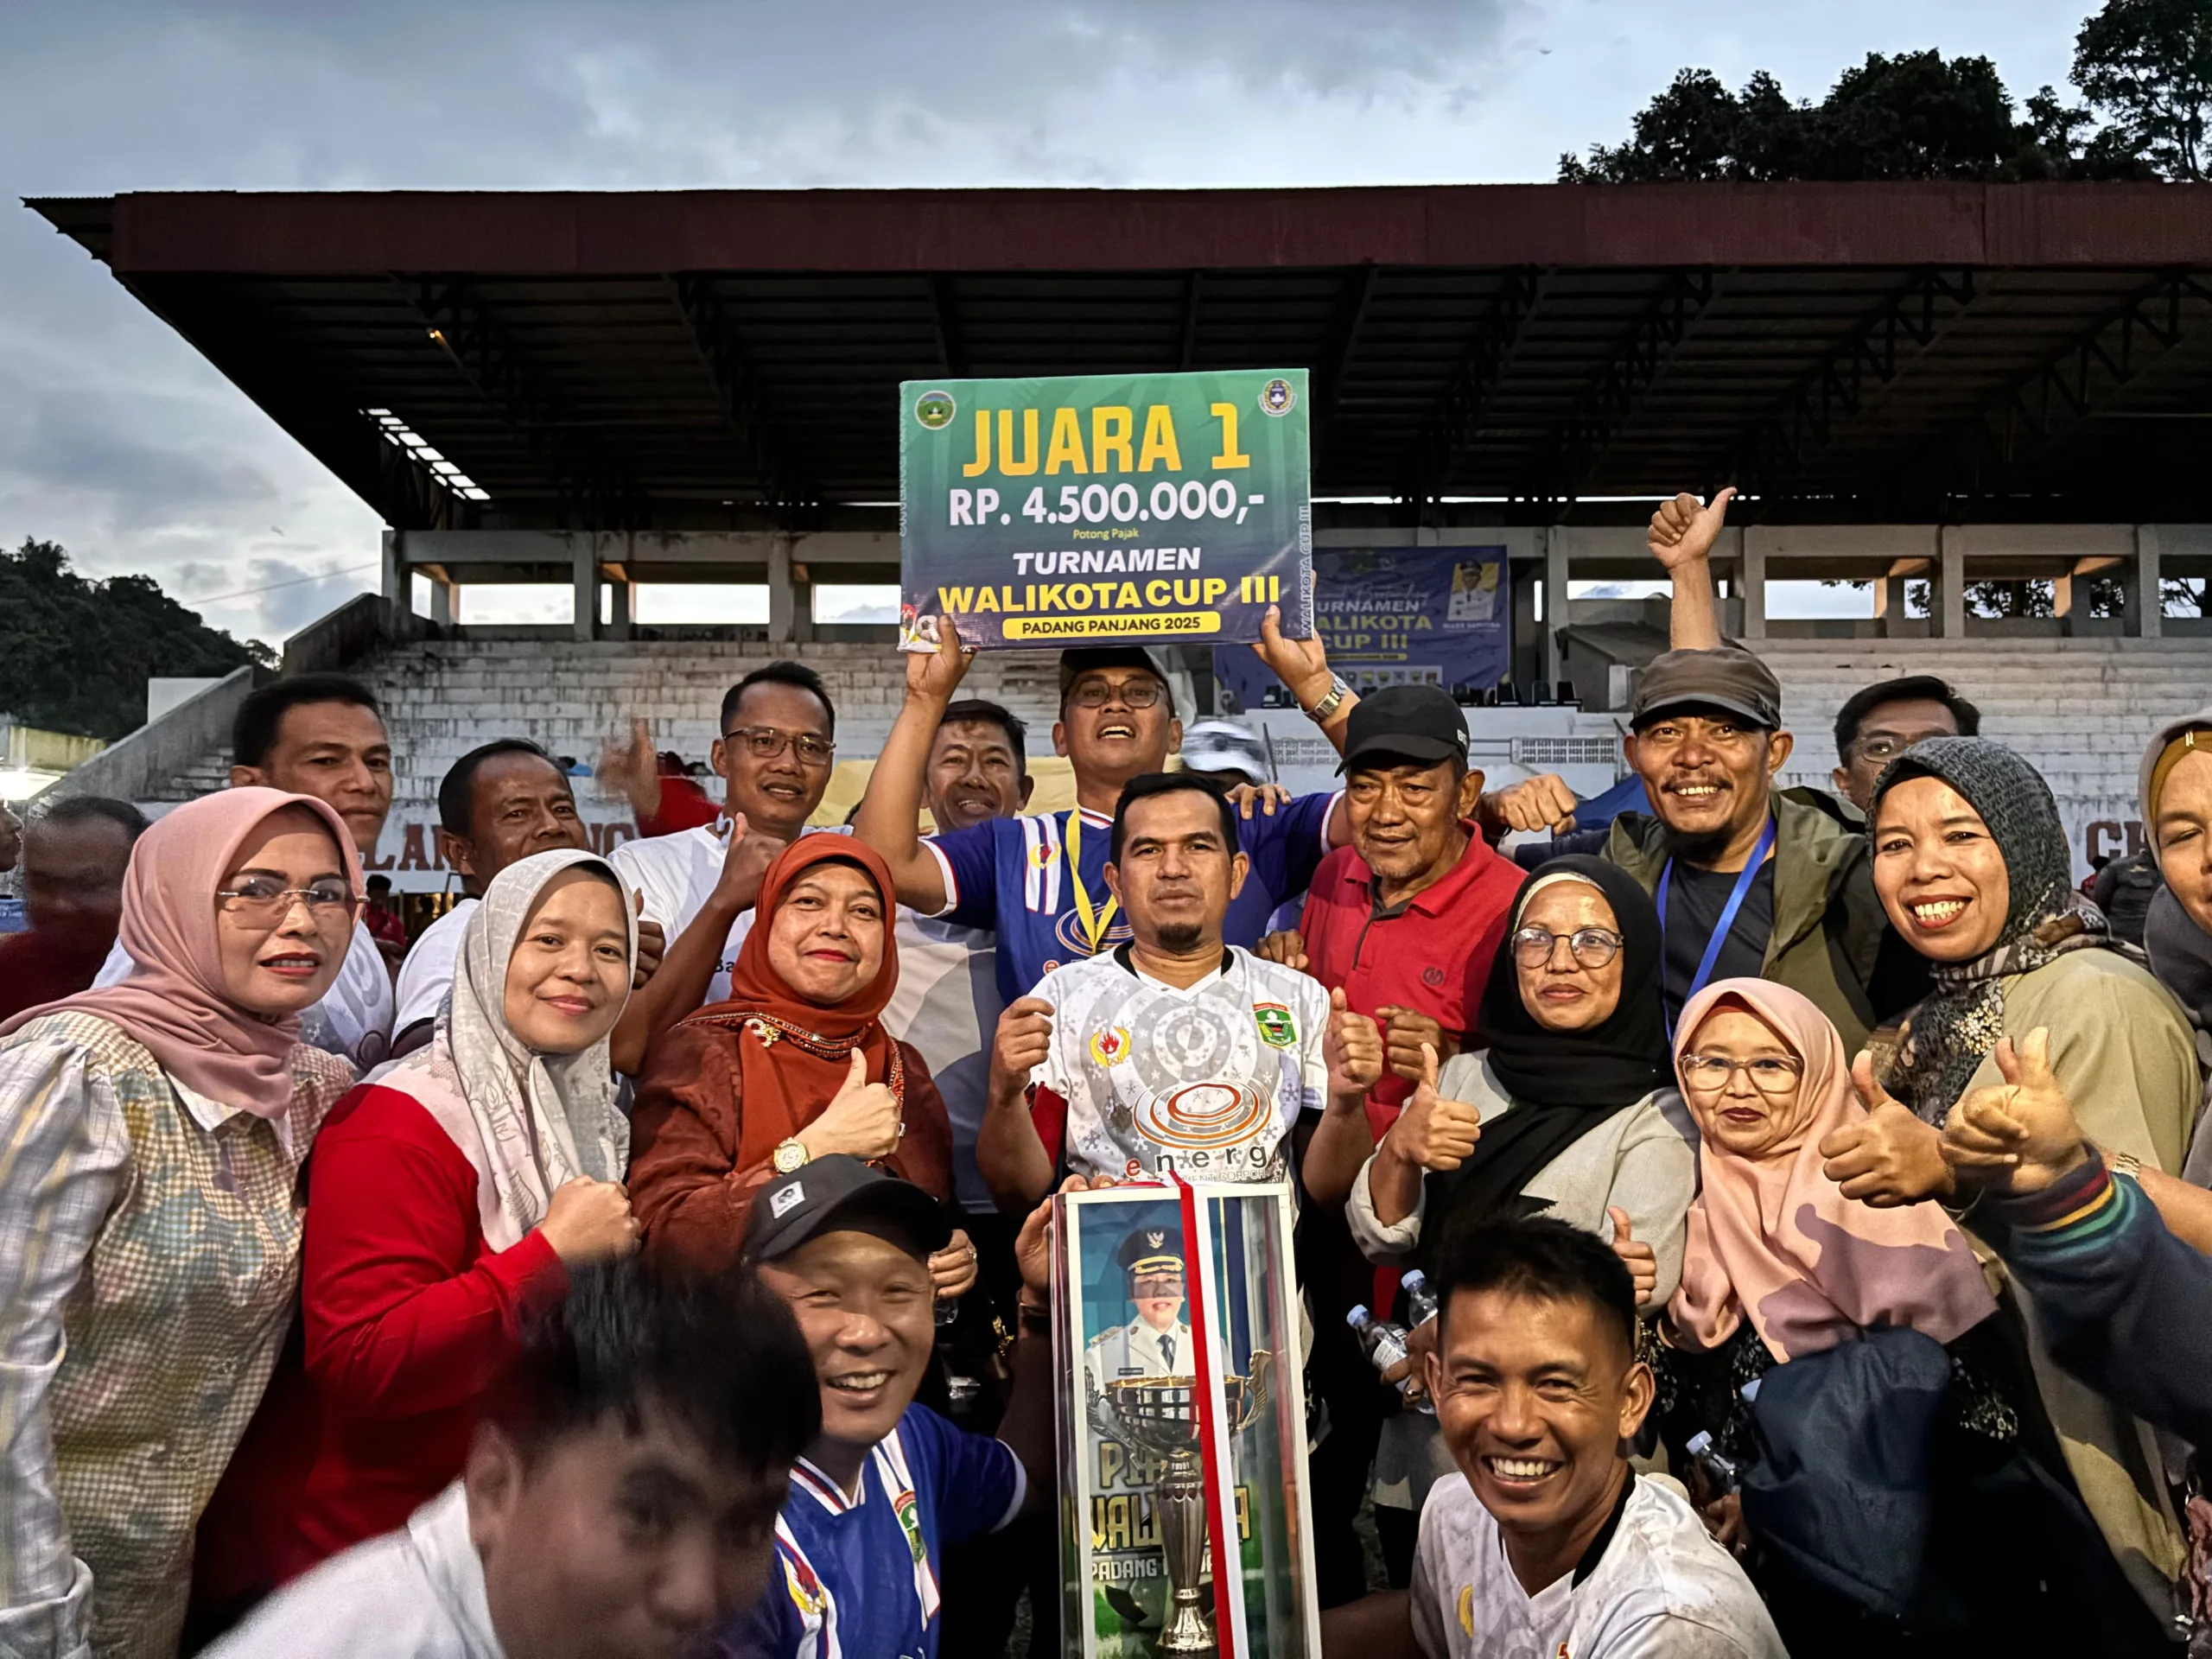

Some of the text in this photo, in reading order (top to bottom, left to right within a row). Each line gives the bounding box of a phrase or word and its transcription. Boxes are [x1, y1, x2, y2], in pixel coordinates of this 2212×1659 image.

[963, 404, 1182, 477] JUARA
[1211, 402, 1250, 469] 1
[950, 479, 1264, 525] RP. 4.500.000,-
[1073, 527, 1139, 541] Potong Pajak
[1013, 547, 1201, 575] TURNAMEN
[1299, 505, 1312, 637] WALIKOTA CUP III
[938, 582, 1142, 613] WALIKOTA
[1146, 578, 1227, 607] CUP
[1241, 575, 1280, 603] III
[1315, 601, 1420, 613] URNAMEN
[1022, 616, 1201, 634] PADANG PANJANG 2025
[1314, 614, 1433, 631] ALIKOTA
[1381, 633, 1408, 649] III
[1126, 1144, 1268, 1177] energ
